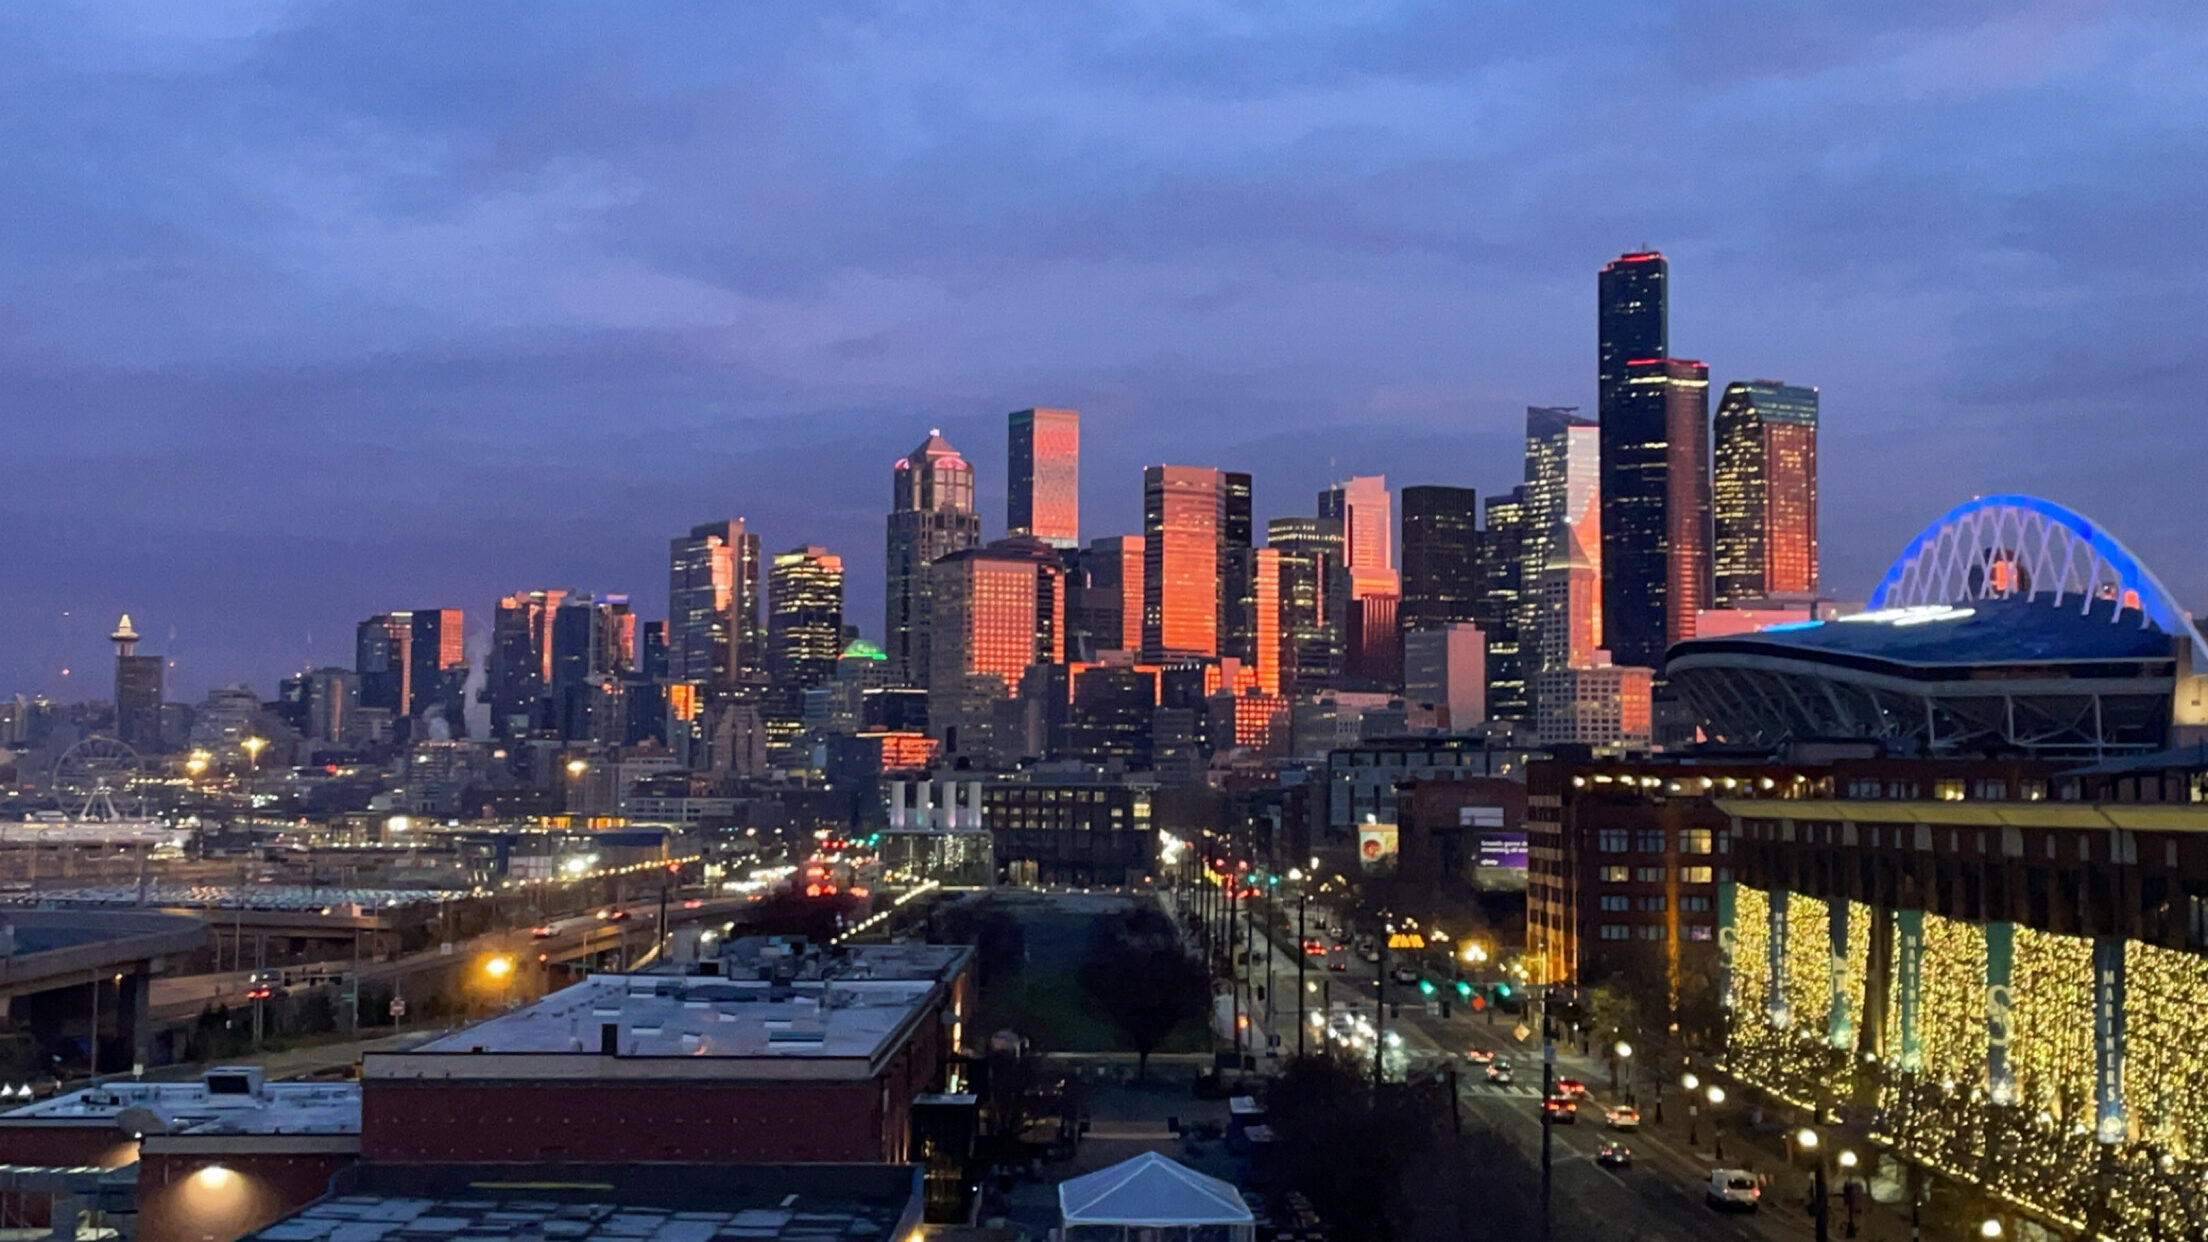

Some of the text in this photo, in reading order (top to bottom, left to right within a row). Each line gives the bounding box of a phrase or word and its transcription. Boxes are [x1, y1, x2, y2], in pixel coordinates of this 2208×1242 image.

[1775, 912, 1783, 1000] MARINERS
[1907, 936, 1917, 1040] MARINERS
[2103, 970, 2116, 1102] MARINERS
